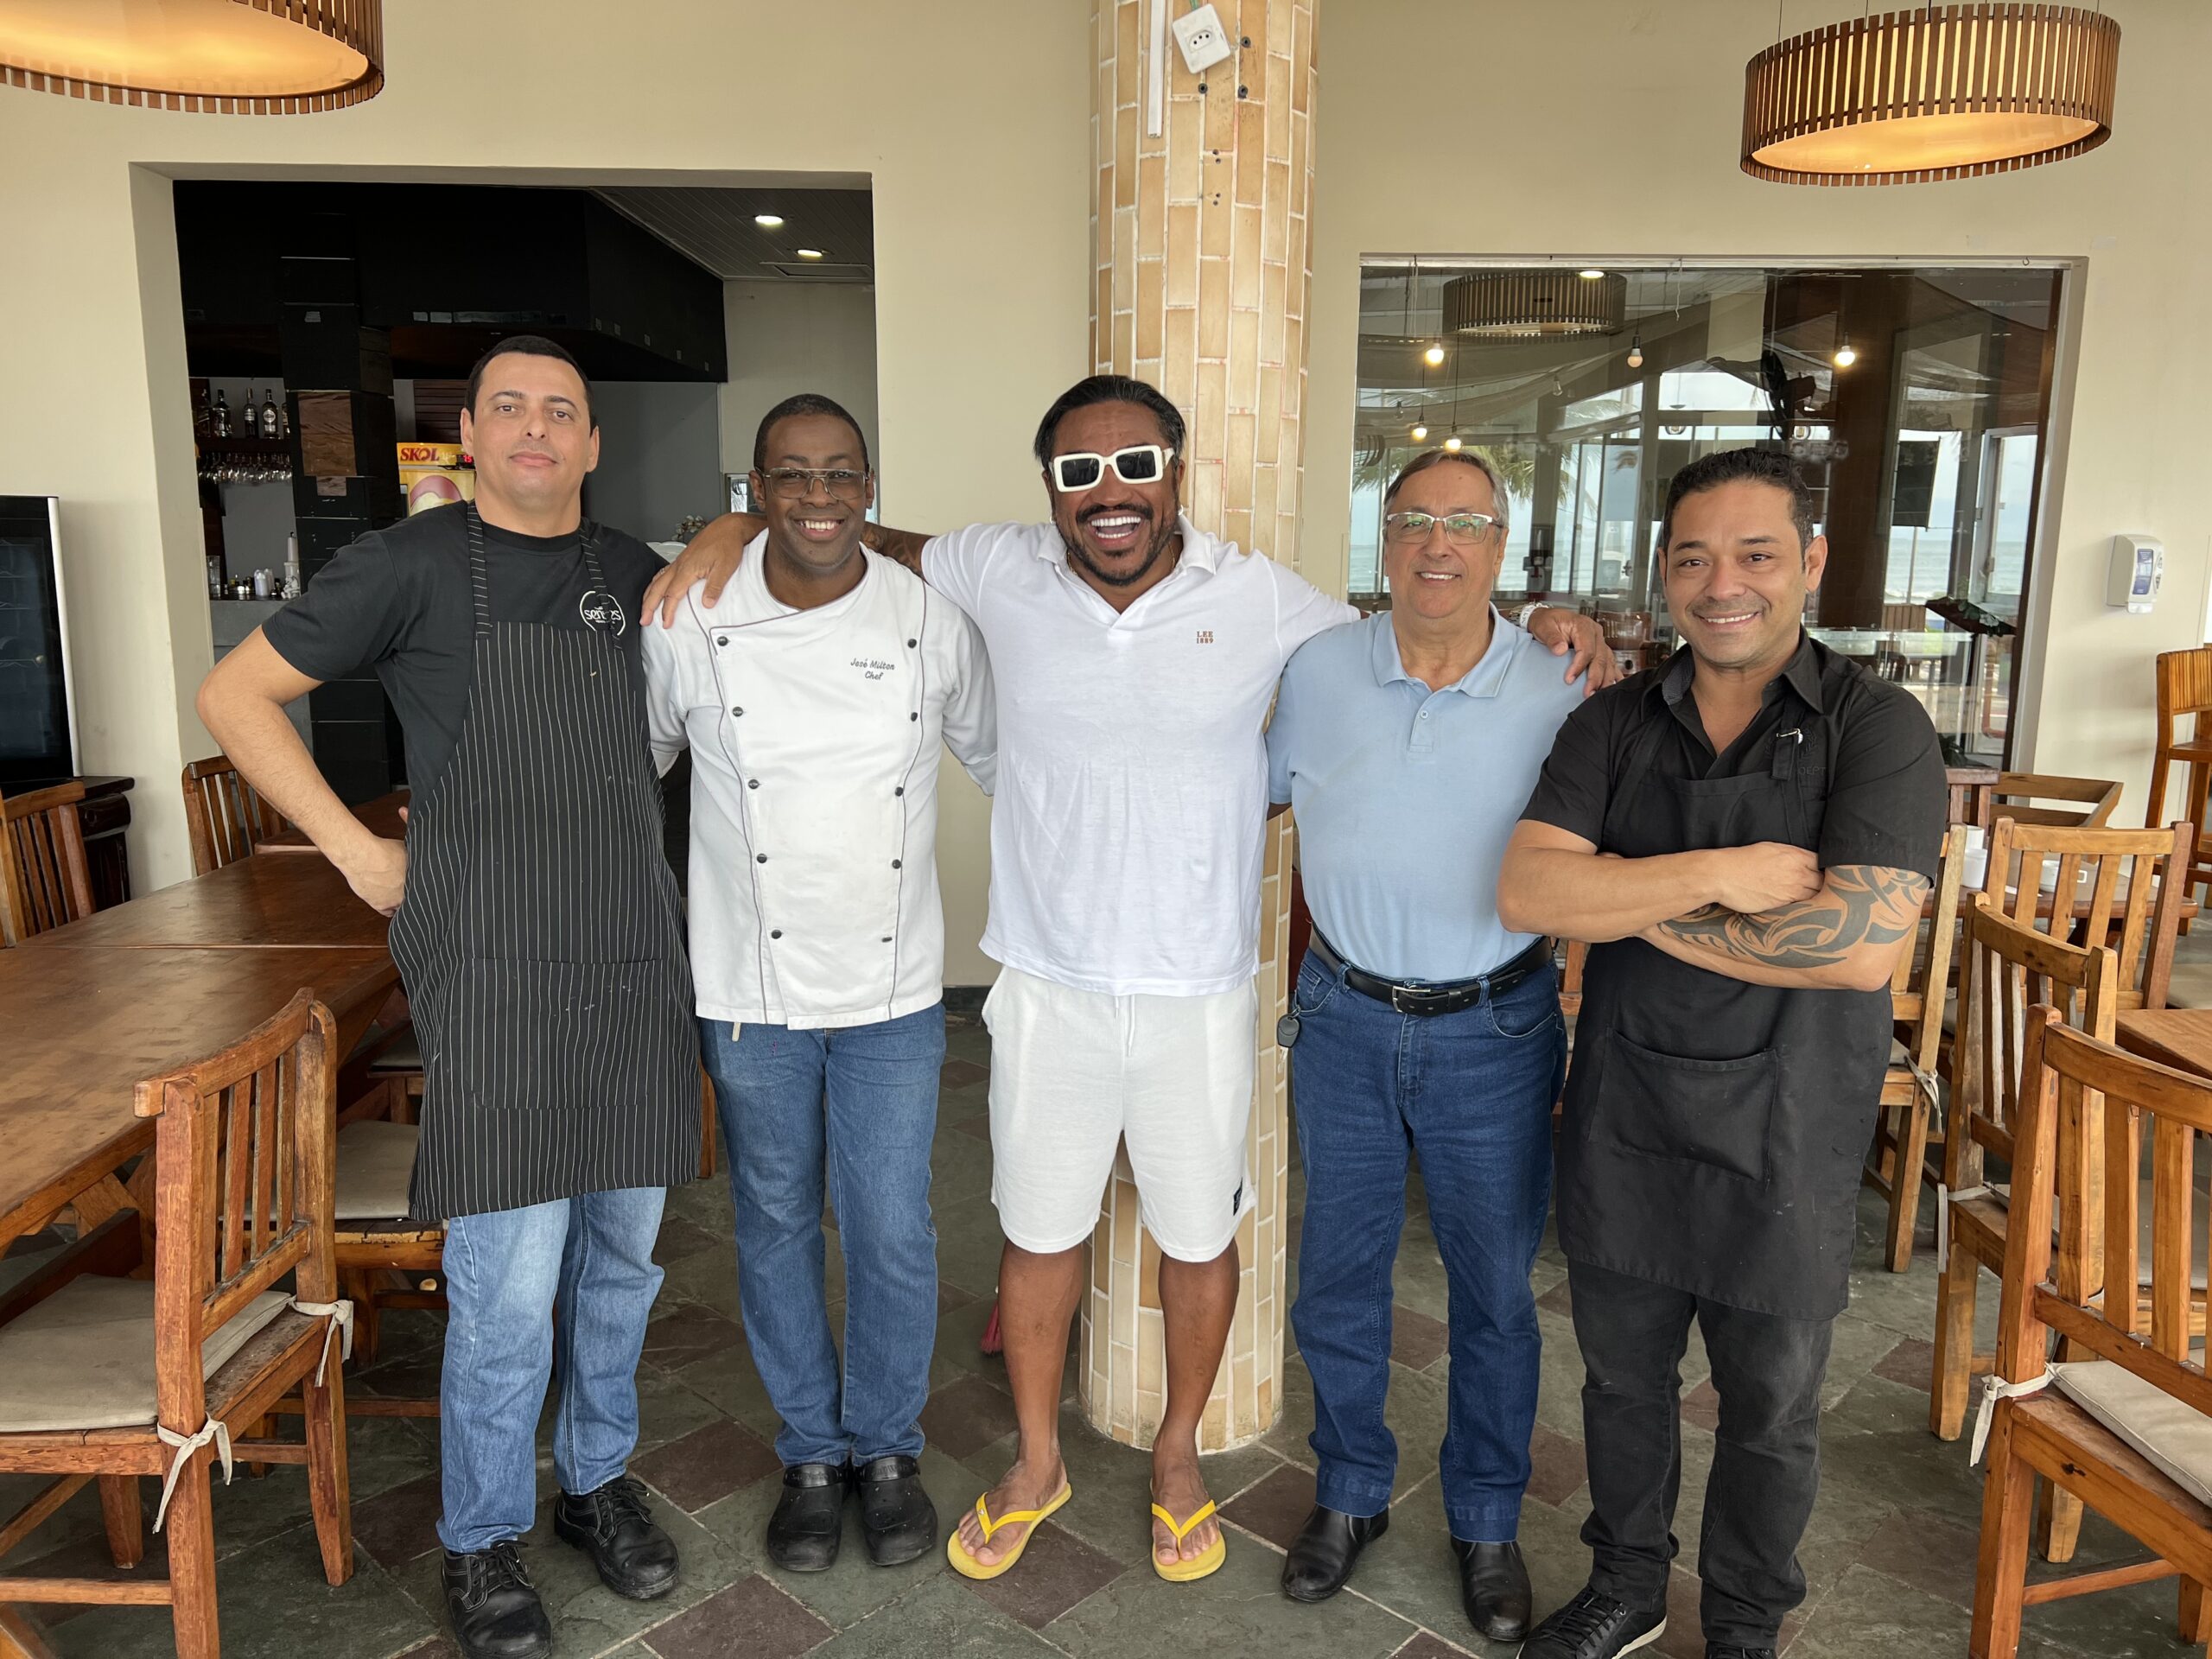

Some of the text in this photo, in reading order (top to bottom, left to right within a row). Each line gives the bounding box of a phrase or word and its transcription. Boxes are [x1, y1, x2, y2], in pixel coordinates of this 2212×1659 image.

[400, 448, 439, 461] SKOL
[850, 658, 895, 671] José Milton
[865, 671, 884, 680] Chef
